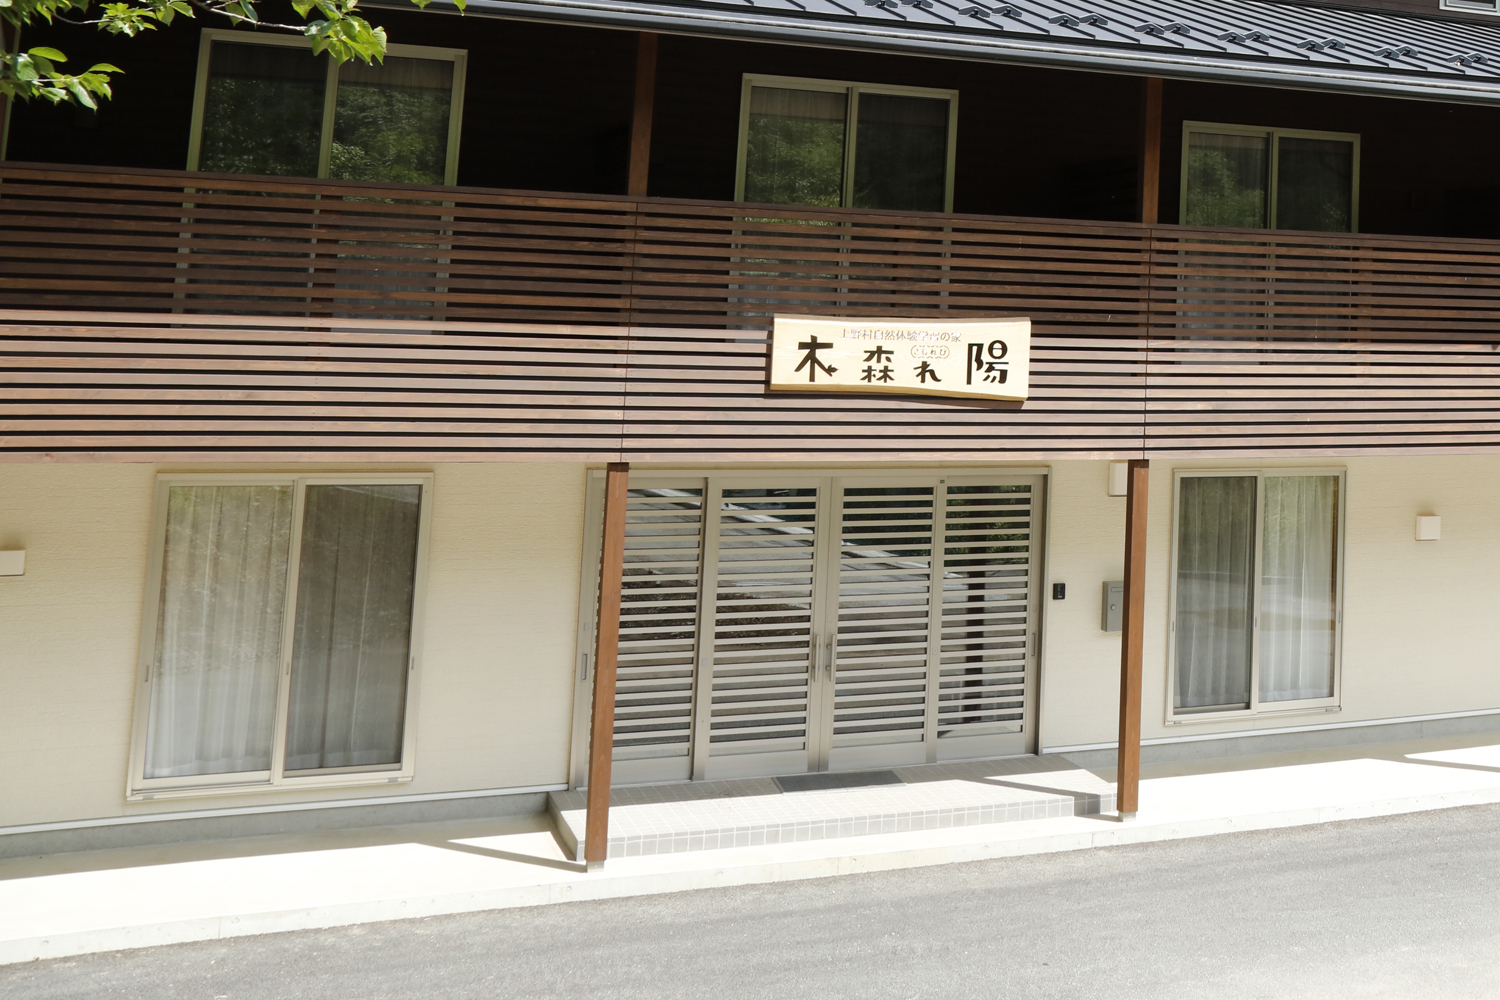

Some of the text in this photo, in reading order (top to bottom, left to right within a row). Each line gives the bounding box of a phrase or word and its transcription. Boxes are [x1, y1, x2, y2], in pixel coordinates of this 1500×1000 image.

[839, 328, 962, 343] 上野村自然体験学習の家
